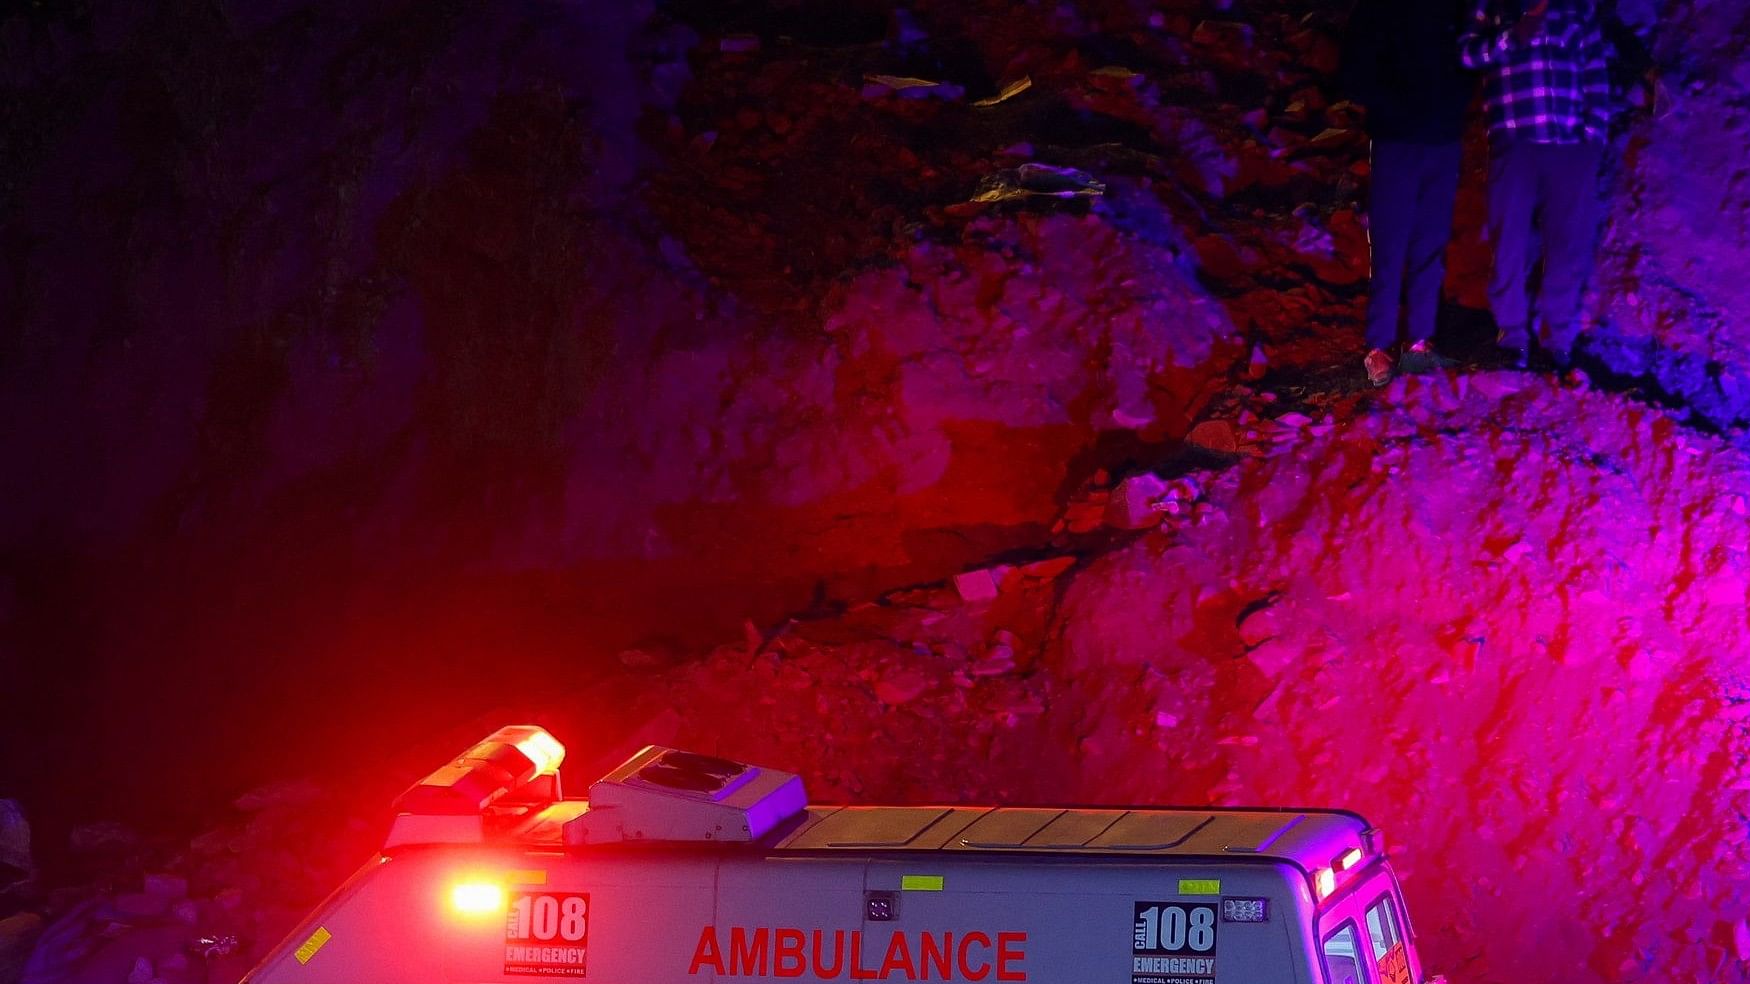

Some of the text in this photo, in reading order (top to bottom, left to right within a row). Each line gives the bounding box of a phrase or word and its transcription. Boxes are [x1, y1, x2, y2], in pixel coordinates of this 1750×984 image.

[512, 895, 586, 940] 108
[1139, 905, 1215, 952] 108
[1134, 921, 1146, 950] CALL
[505, 945, 586, 965] EMERGENCY
[687, 925, 1028, 982] AMBULANCE
[1133, 957, 1215, 975] EMERGENCY
[1137, 977, 1166, 984] MEDICAL
[1170, 977, 1194, 984] POLICE
